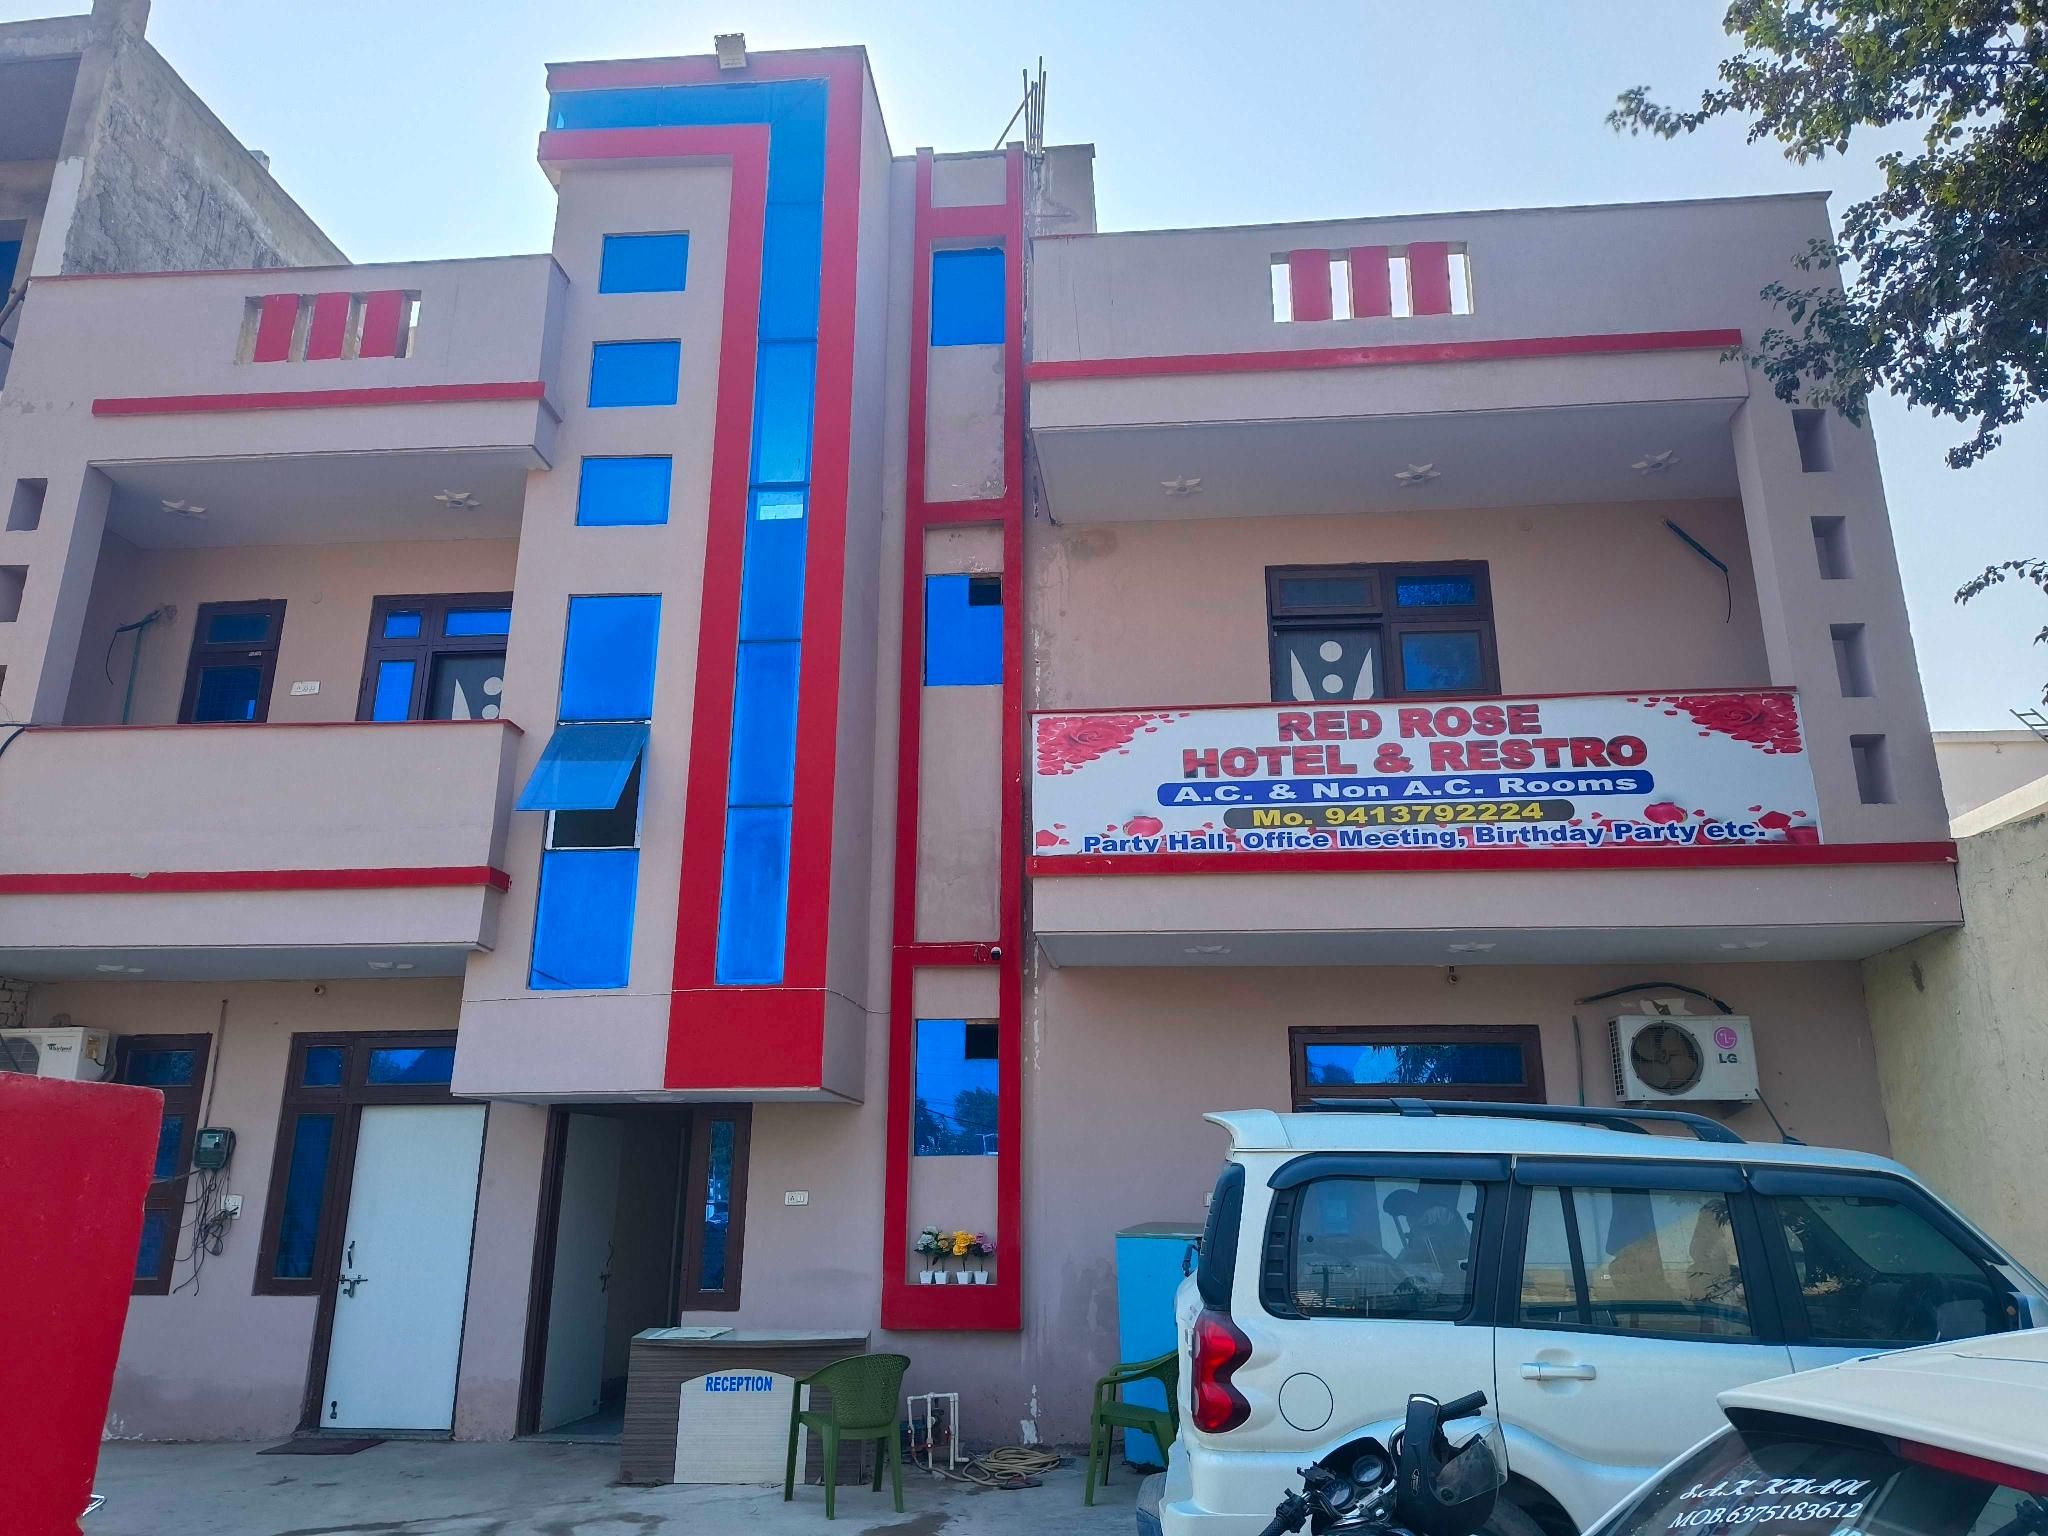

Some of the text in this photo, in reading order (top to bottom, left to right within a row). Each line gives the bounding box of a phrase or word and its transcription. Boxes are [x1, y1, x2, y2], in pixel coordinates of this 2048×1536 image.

[1277, 703, 1543, 742] RED ROSE
[1182, 735, 1648, 779] HOTEL & RESTRO
[1174, 777, 1638, 803] A.C. & Non A.C. Rooms
[1252, 802, 1544, 827] Mo. 9413792224
[1084, 821, 1767, 853] Party Hall, Office Meeting, Birthday Party etc.
[1719, 1053, 1738, 1064] LG
[705, 1376, 773, 1392] RECEPTION
[1668, 1501, 1864, 1529] MOB.6375183612
